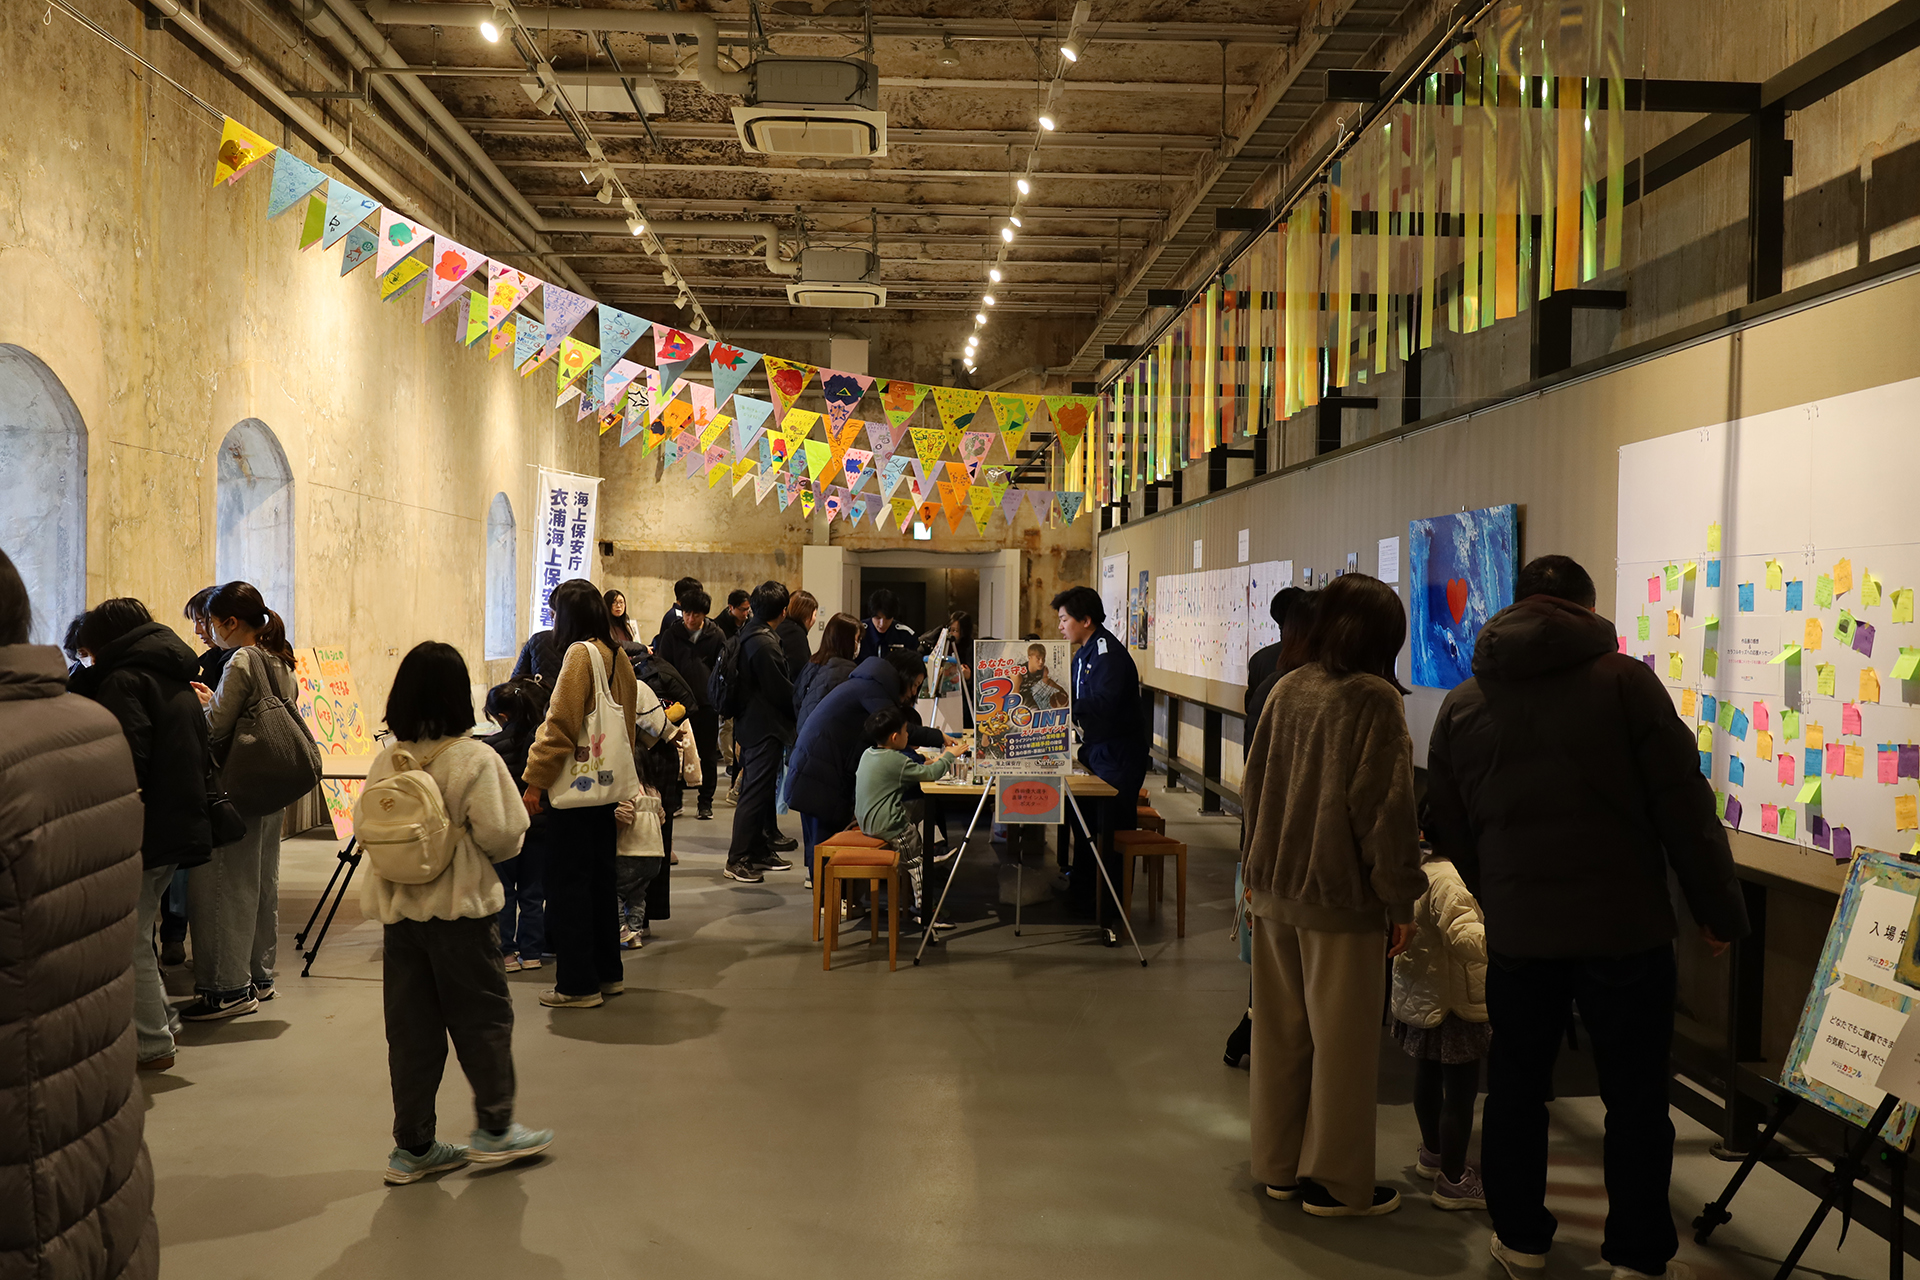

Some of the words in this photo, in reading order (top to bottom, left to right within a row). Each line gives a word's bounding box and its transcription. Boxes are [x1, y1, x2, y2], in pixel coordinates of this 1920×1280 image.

[568, 491, 590, 572] 海上保安庁
[540, 488, 569, 628] 衣浦海上保安署
[978, 658, 1014, 670] あなたの
[994, 666, 1028, 678] 命を守る
[1020, 726, 1066, 737] スリーポイント
[1842, 1064, 1862, 1078] カラフル
